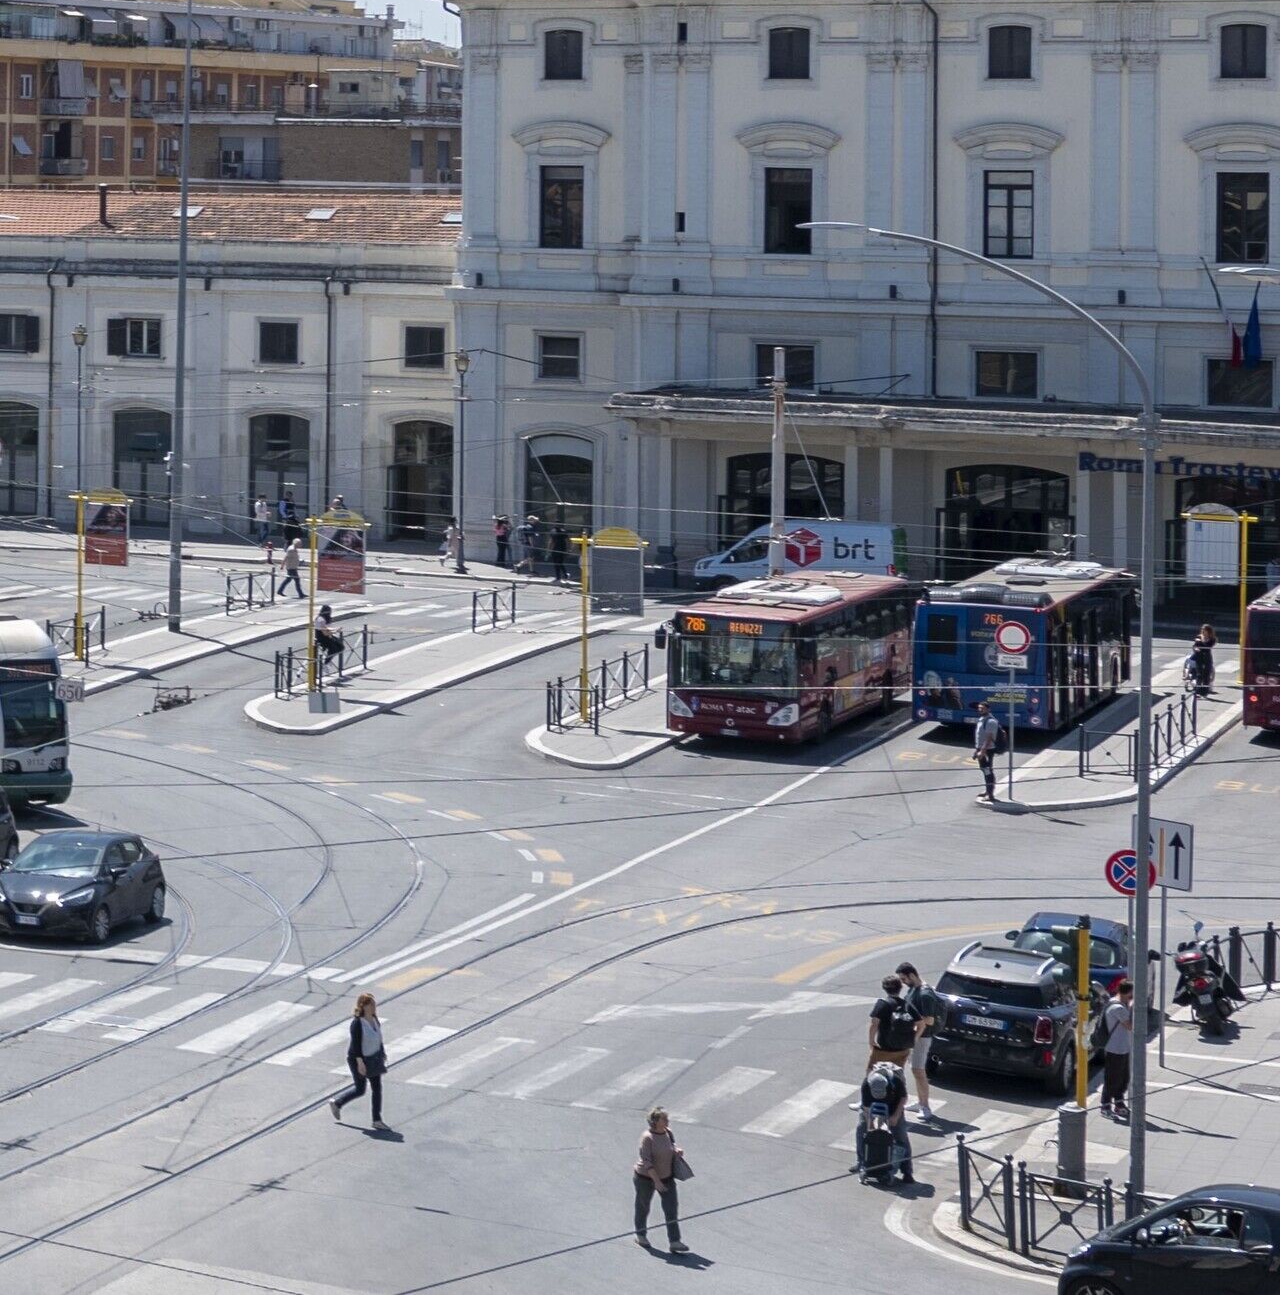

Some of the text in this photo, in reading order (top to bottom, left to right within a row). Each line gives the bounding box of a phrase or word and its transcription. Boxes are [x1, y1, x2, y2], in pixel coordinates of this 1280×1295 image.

[833, 537, 875, 560] brt
[687, 617, 705, 631] 786
[58, 685, 83, 700] 650
[701, 702, 756, 714] ROMA atac
